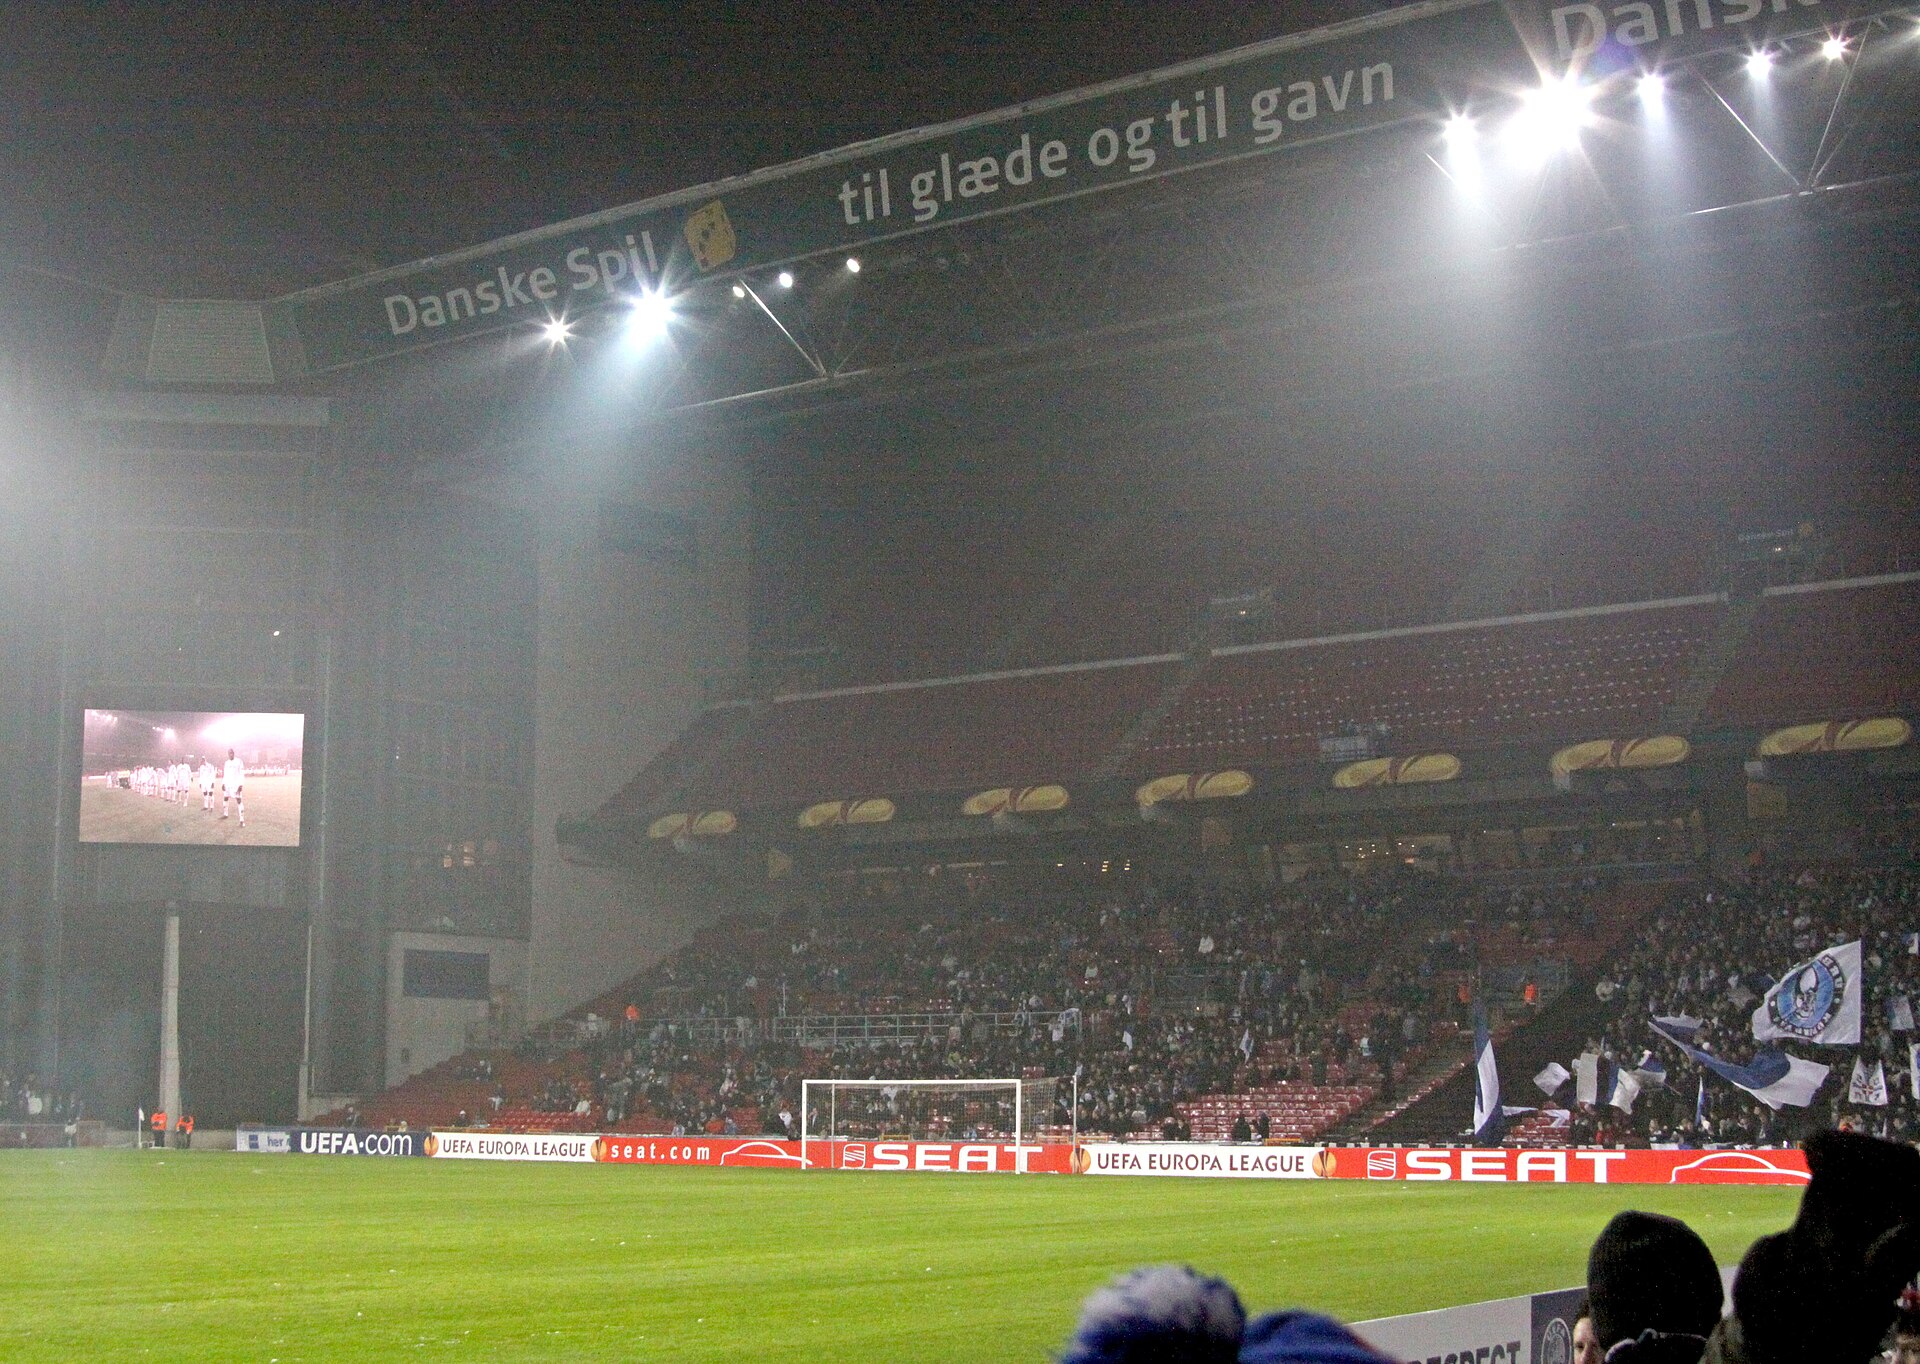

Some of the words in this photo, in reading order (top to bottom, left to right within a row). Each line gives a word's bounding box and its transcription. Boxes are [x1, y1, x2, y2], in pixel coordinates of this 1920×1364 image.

[838, 168, 891, 225] til
[910, 133, 1069, 222] glæde
[1087, 117, 1156, 173] og
[1166, 86, 1227, 148] til
[1250, 62, 1395, 144] gavn
[383, 265, 559, 336] Danske
[566, 230, 660, 294] Spil
[443, 1139, 474, 1154] UEFA
[478, 1140, 530, 1156] EUROPA
[534, 1142, 586, 1157] LEAGUE
[610, 1142, 711, 1161] seat.com
[872, 1144, 1043, 1173] SEAT
[1097, 1153, 1142, 1170] UEFA
[1148, 1153, 1223, 1171] EUROPA
[1229, 1154, 1305, 1173] LEAGUE
[1405, 1150, 1627, 1184] SEAT
